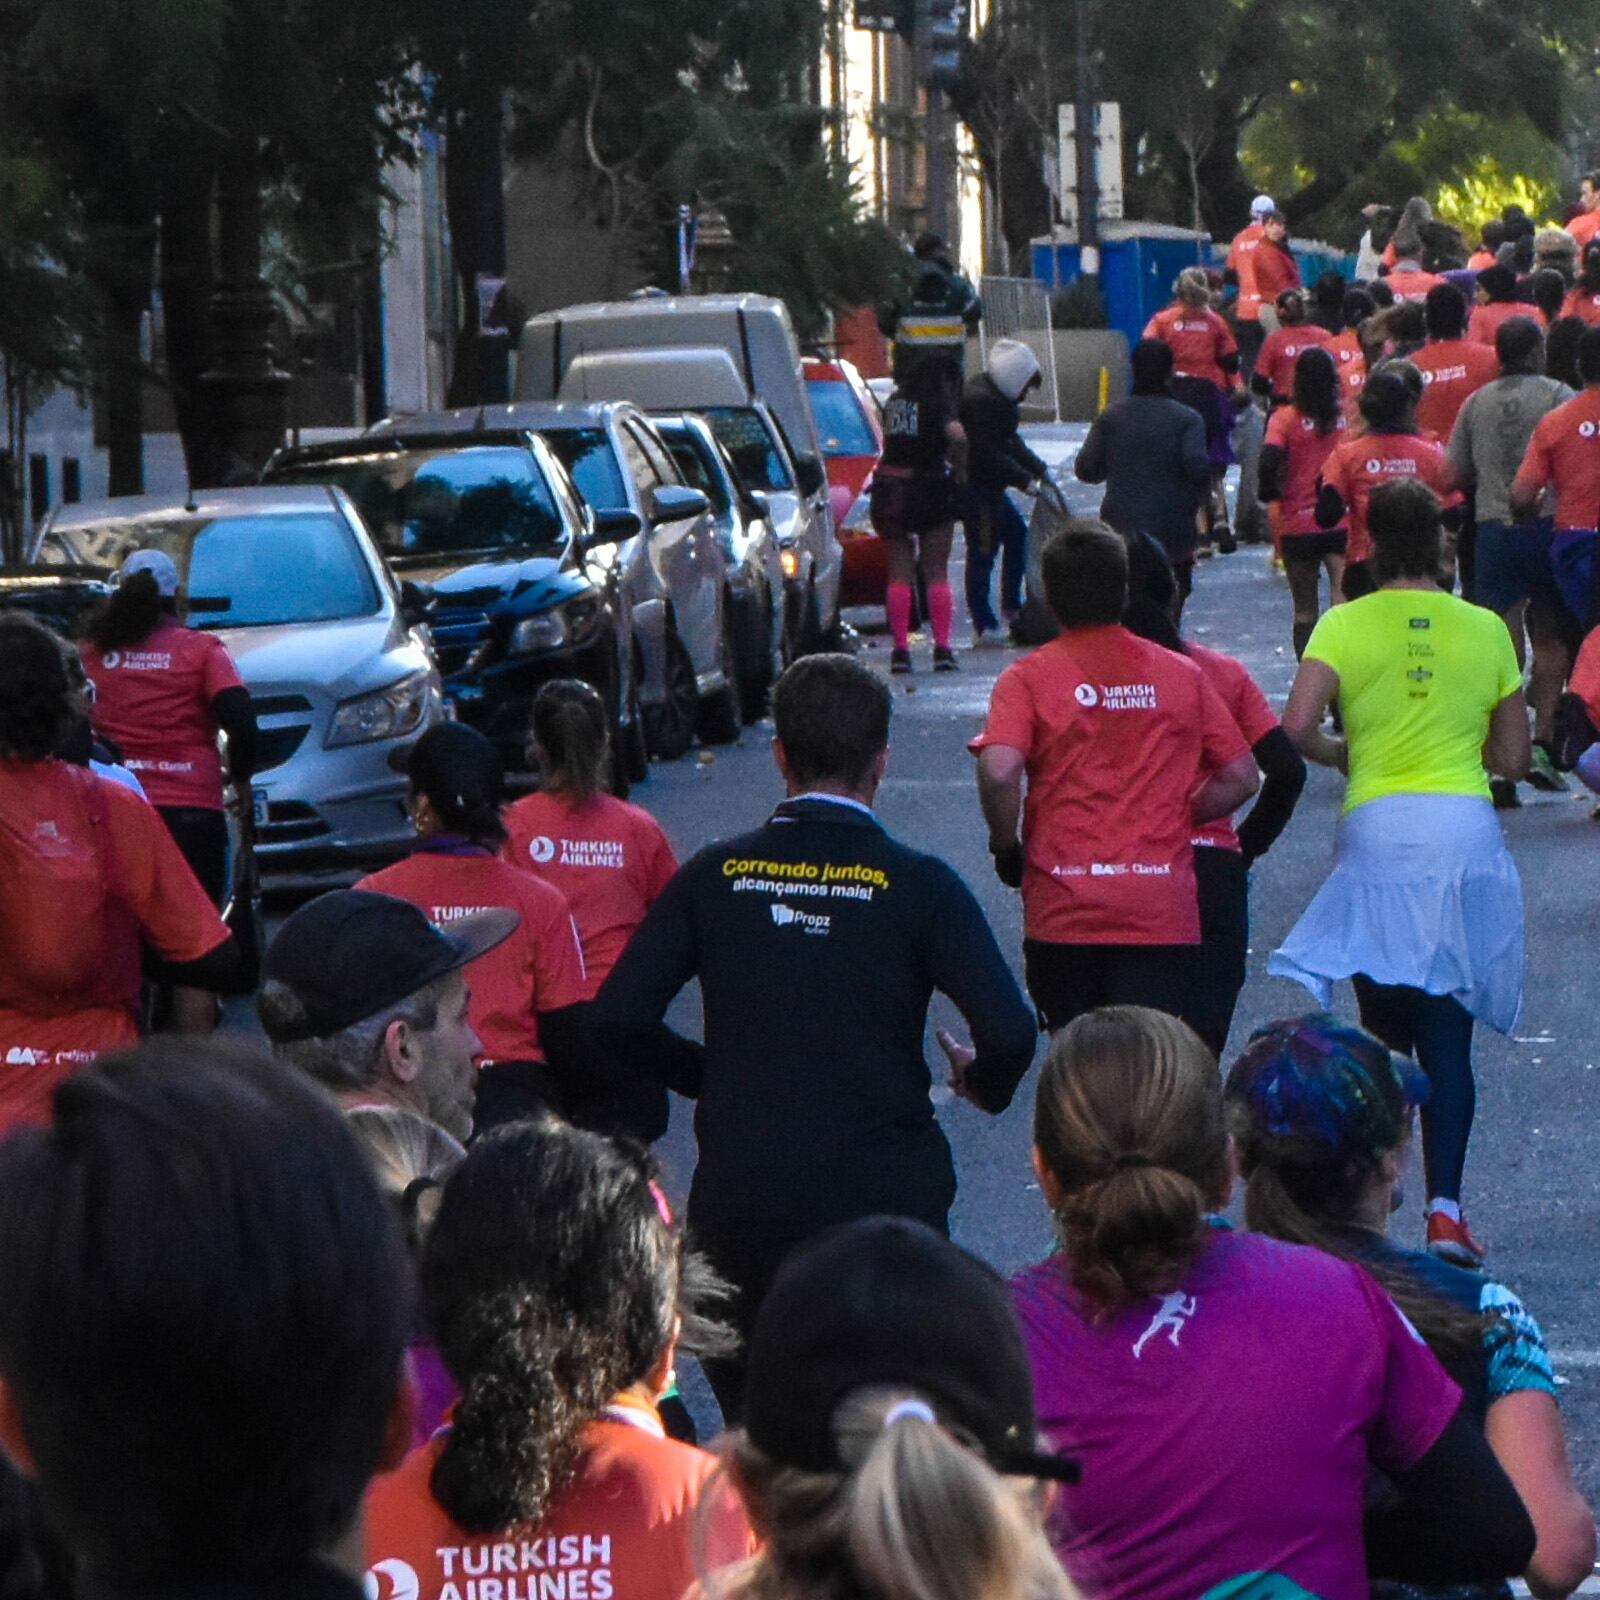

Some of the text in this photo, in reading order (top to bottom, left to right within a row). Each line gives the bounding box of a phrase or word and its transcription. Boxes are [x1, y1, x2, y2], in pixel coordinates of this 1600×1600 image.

[1100, 684, 1156, 698] URKISH
[560, 839, 624, 855] TURKISH
[559, 852, 625, 869] AIRLINES
[722, 858, 889, 890] Correndo juntos,
[732, 876, 875, 901] alcançamos mais!
[431, 906, 491, 921] TURKI
[795, 910, 832, 928] Propz
[435, 1533, 612, 1578] TURKISH
[438, 1567, 614, 1600] AIRLINES
